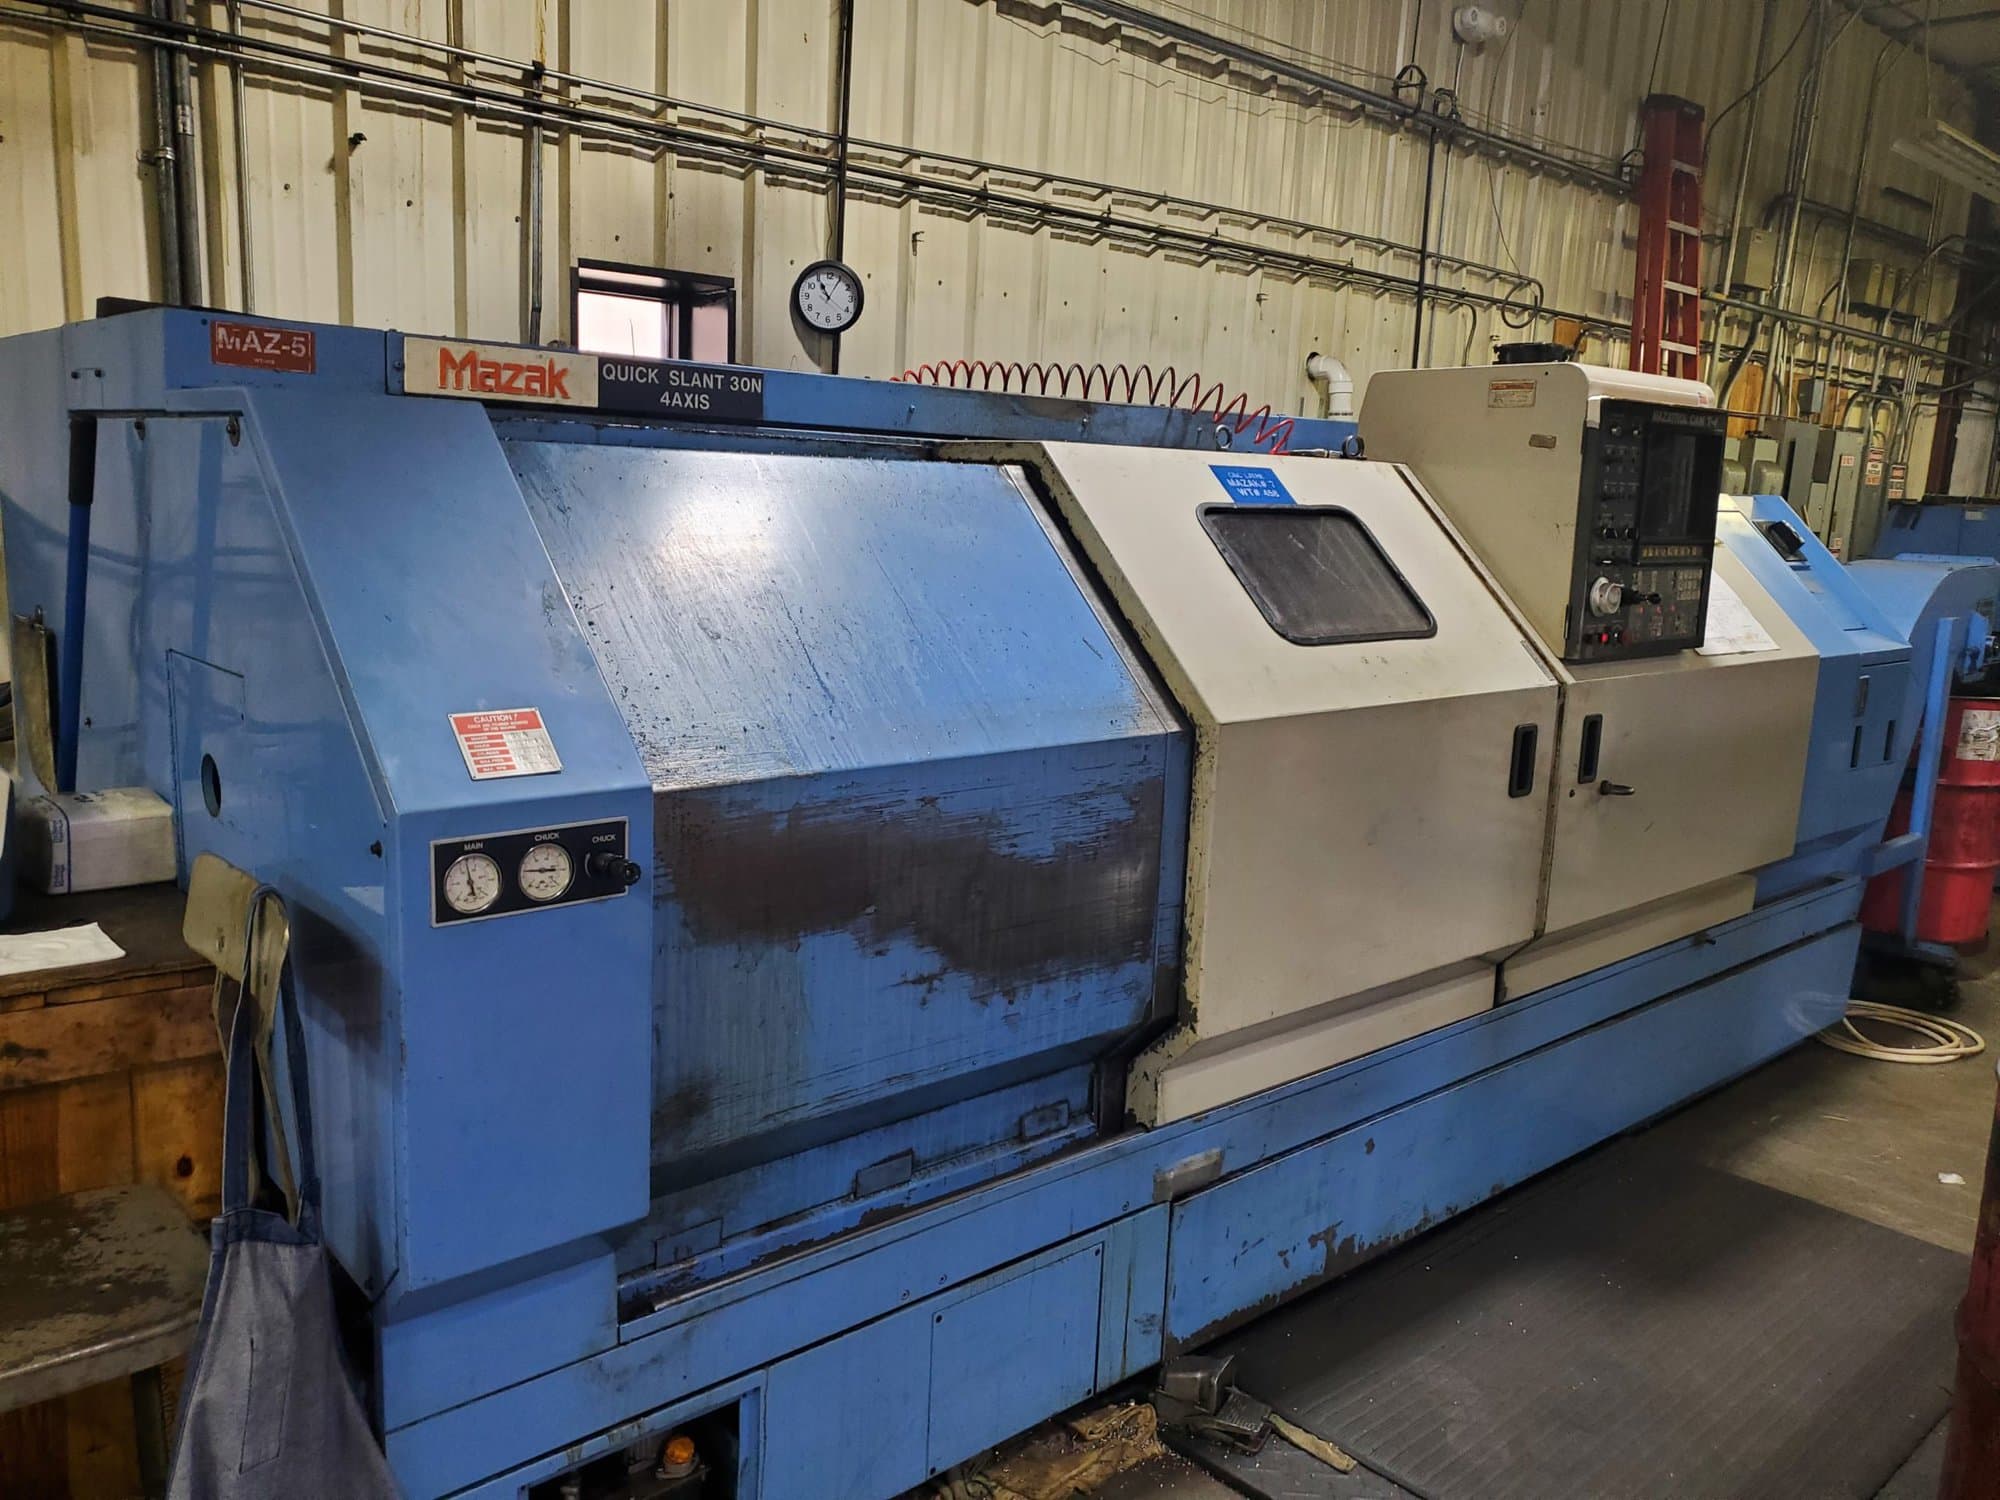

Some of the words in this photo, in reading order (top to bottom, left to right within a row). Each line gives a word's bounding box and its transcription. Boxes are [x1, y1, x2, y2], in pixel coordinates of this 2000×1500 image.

[845, 283, 851, 291] 2
[804, 292, 810, 300] 9
[848, 295, 853, 303] 3
[807, 303, 813, 311] 8
[825, 315, 831, 323] 6
[836, 313, 842, 321] 5
[217, 327, 306, 358] MAZ-5
[438, 347, 571, 399] Mazak
[602, 363, 660, 385] QUICK
[669, 369, 725, 390] SLANT
[730, 375, 763, 394] 30N
[659, 391, 711, 410] 4AXIS
[534, 832, 560, 842] CHUCK
[591, 833, 617, 845] CHUCK
[463, 842, 484, 851] MAIN
